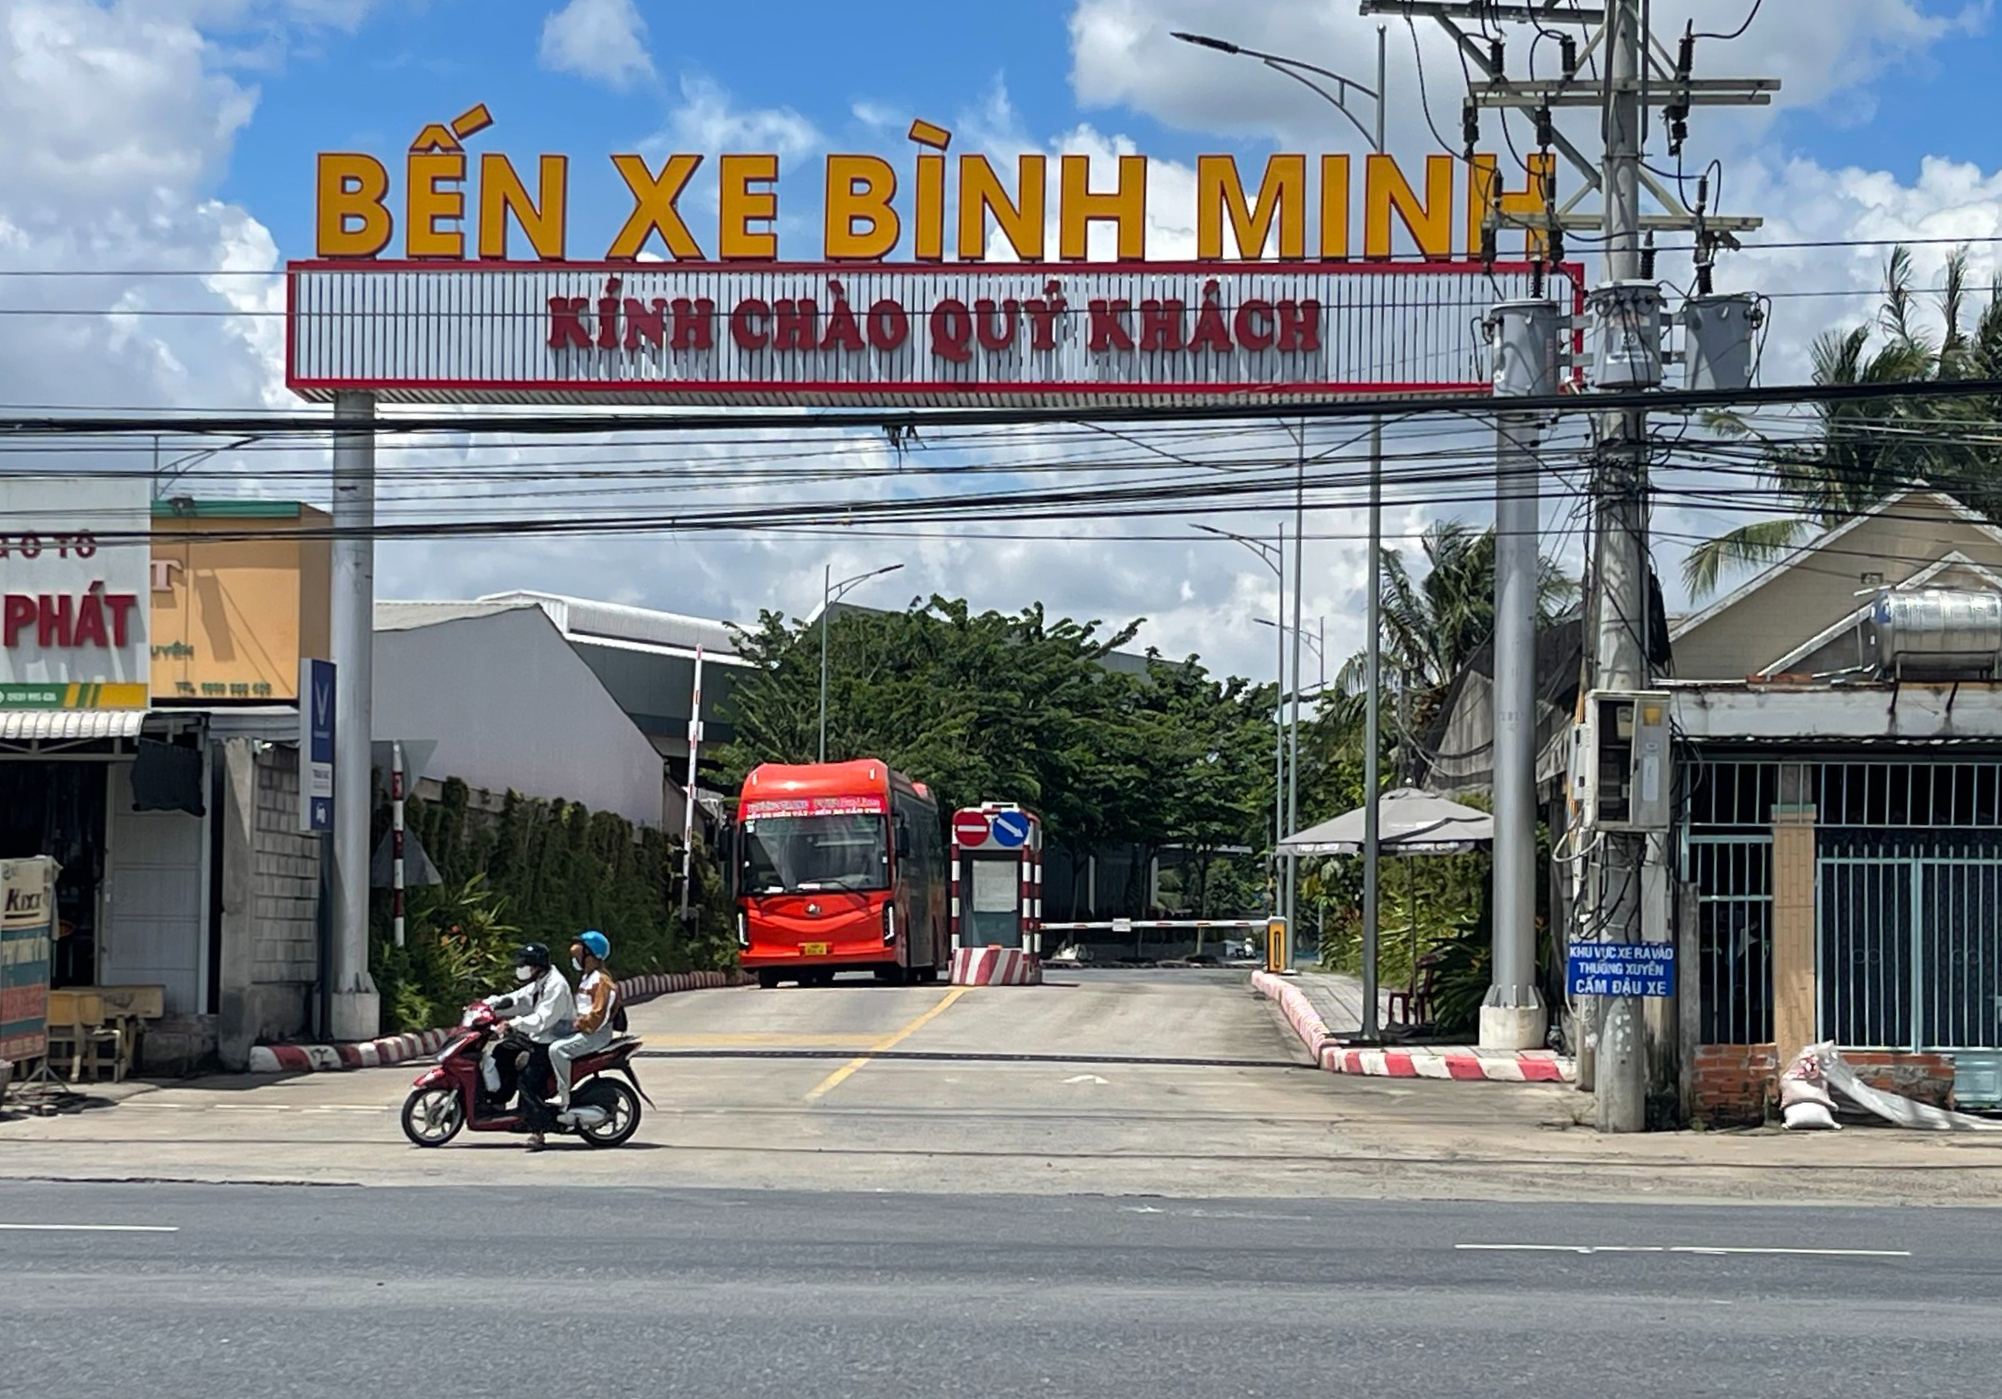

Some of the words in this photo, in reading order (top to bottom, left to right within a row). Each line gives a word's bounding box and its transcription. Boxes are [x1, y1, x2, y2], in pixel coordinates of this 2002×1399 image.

[317, 103, 568, 259] BẾN
[605, 153, 779, 260] XE
[824, 118, 1148, 261] BÌNH
[1197, 153, 1557, 261] MINH
[548, 277, 714, 350] KÍNH
[731, 279, 910, 350] CHÀO
[930, 279, 1068, 363] QUÝ
[1088, 279, 1322, 352] KHÁCH
[4, 580, 136, 647] PHÁT
[1569, 946, 1592, 958] KHU
[1617, 947, 1633, 959] XE
[1634, 947, 1650, 959] RA
[1626, 960, 1664, 976] XUYÊN
[1575, 974, 1607, 993] CẤM
[1612, 977, 1642, 996] ĐẬU
[1647, 980, 1667, 995] XE
